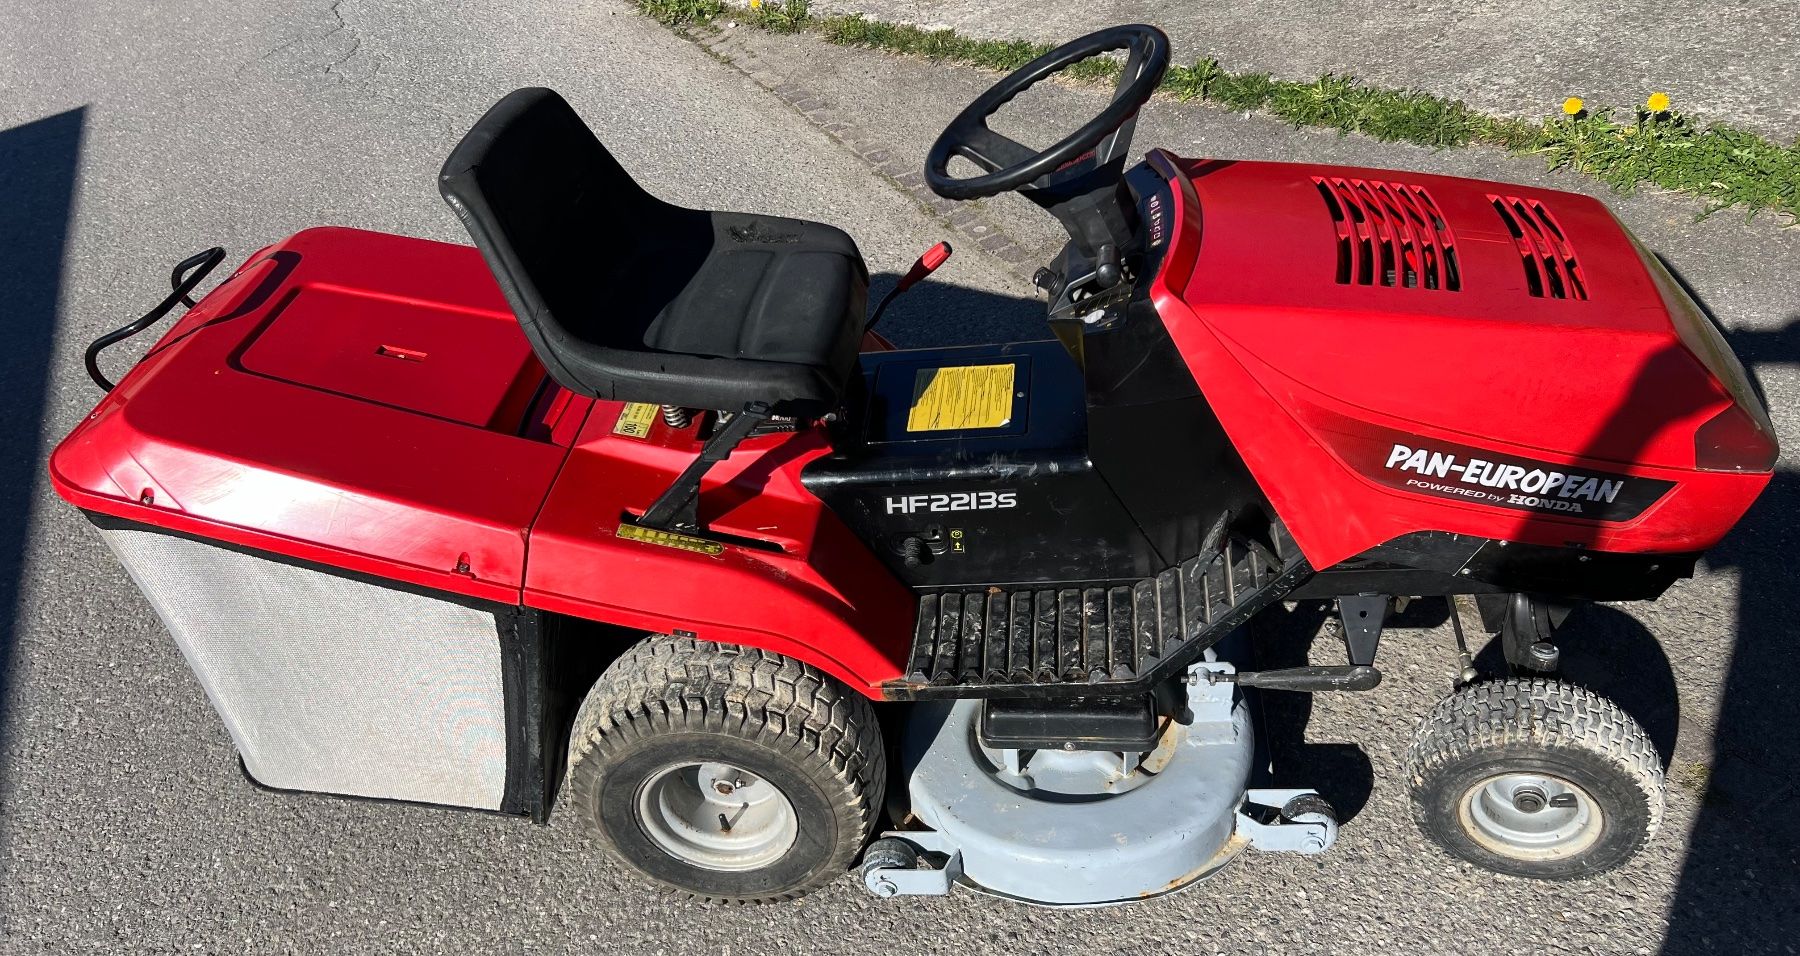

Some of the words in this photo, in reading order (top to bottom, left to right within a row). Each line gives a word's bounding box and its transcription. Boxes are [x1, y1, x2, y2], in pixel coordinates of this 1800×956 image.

[1385, 444, 1624, 504] PAN-EUROPEAN
[886, 491, 1017, 515] HF2213S
[1406, 479, 1486, 499] POWERED
[1488, 494, 1504, 503] by
[1507, 493, 1583, 513] HONDA
